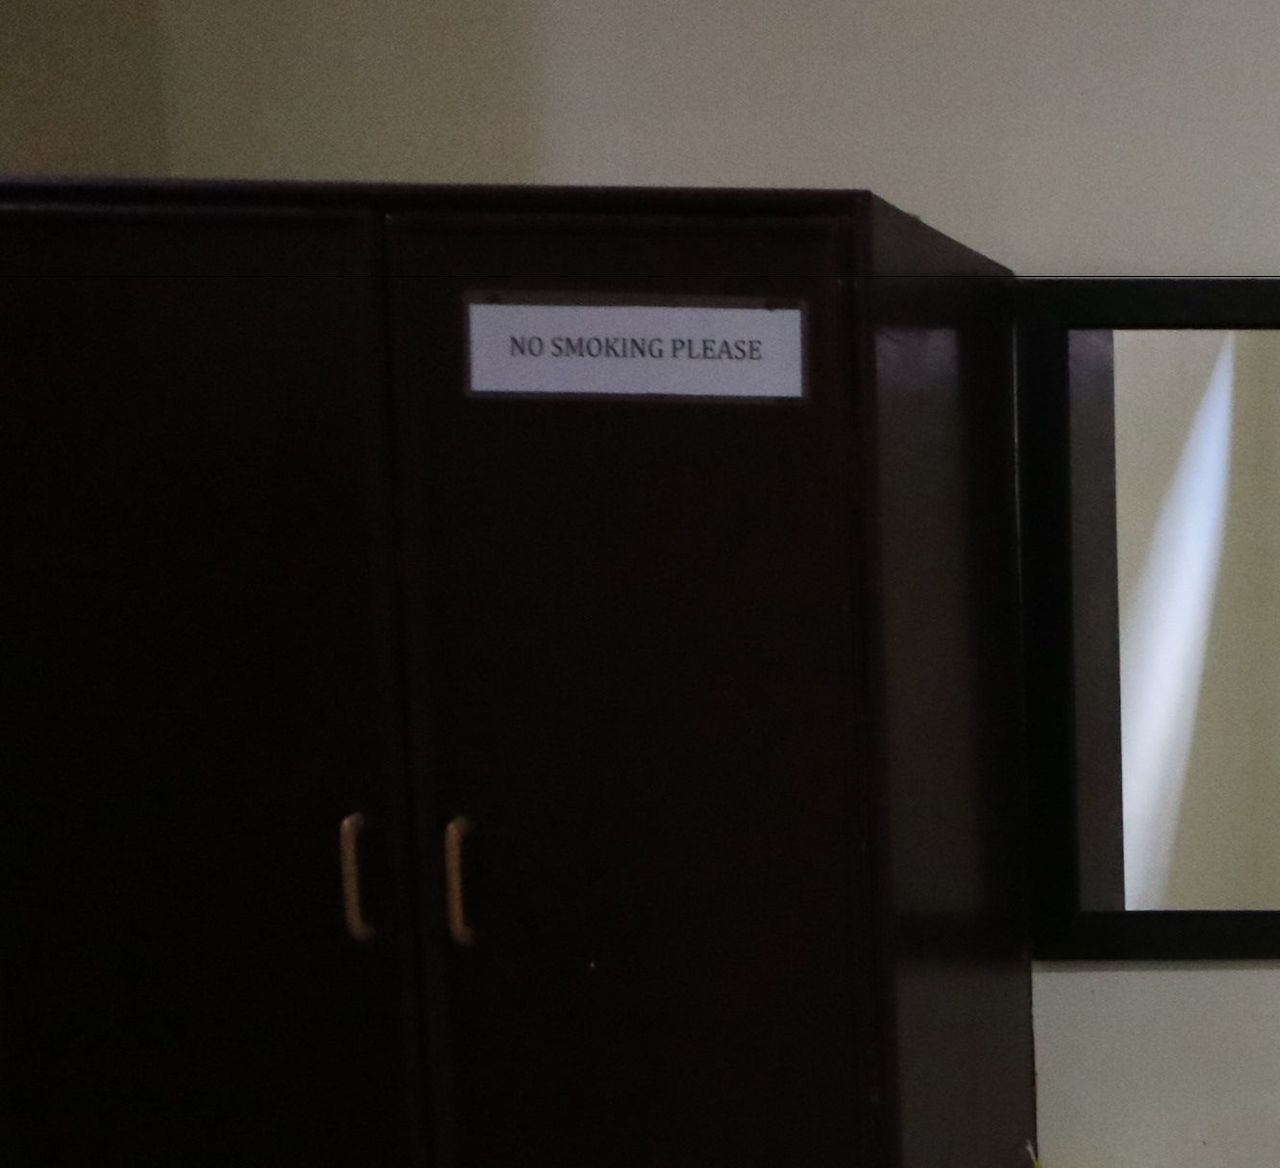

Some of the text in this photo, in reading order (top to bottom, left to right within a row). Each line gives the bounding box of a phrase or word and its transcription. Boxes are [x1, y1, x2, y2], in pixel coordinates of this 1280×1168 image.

[510, 335, 763, 361] NO SMOKING PLEASE
